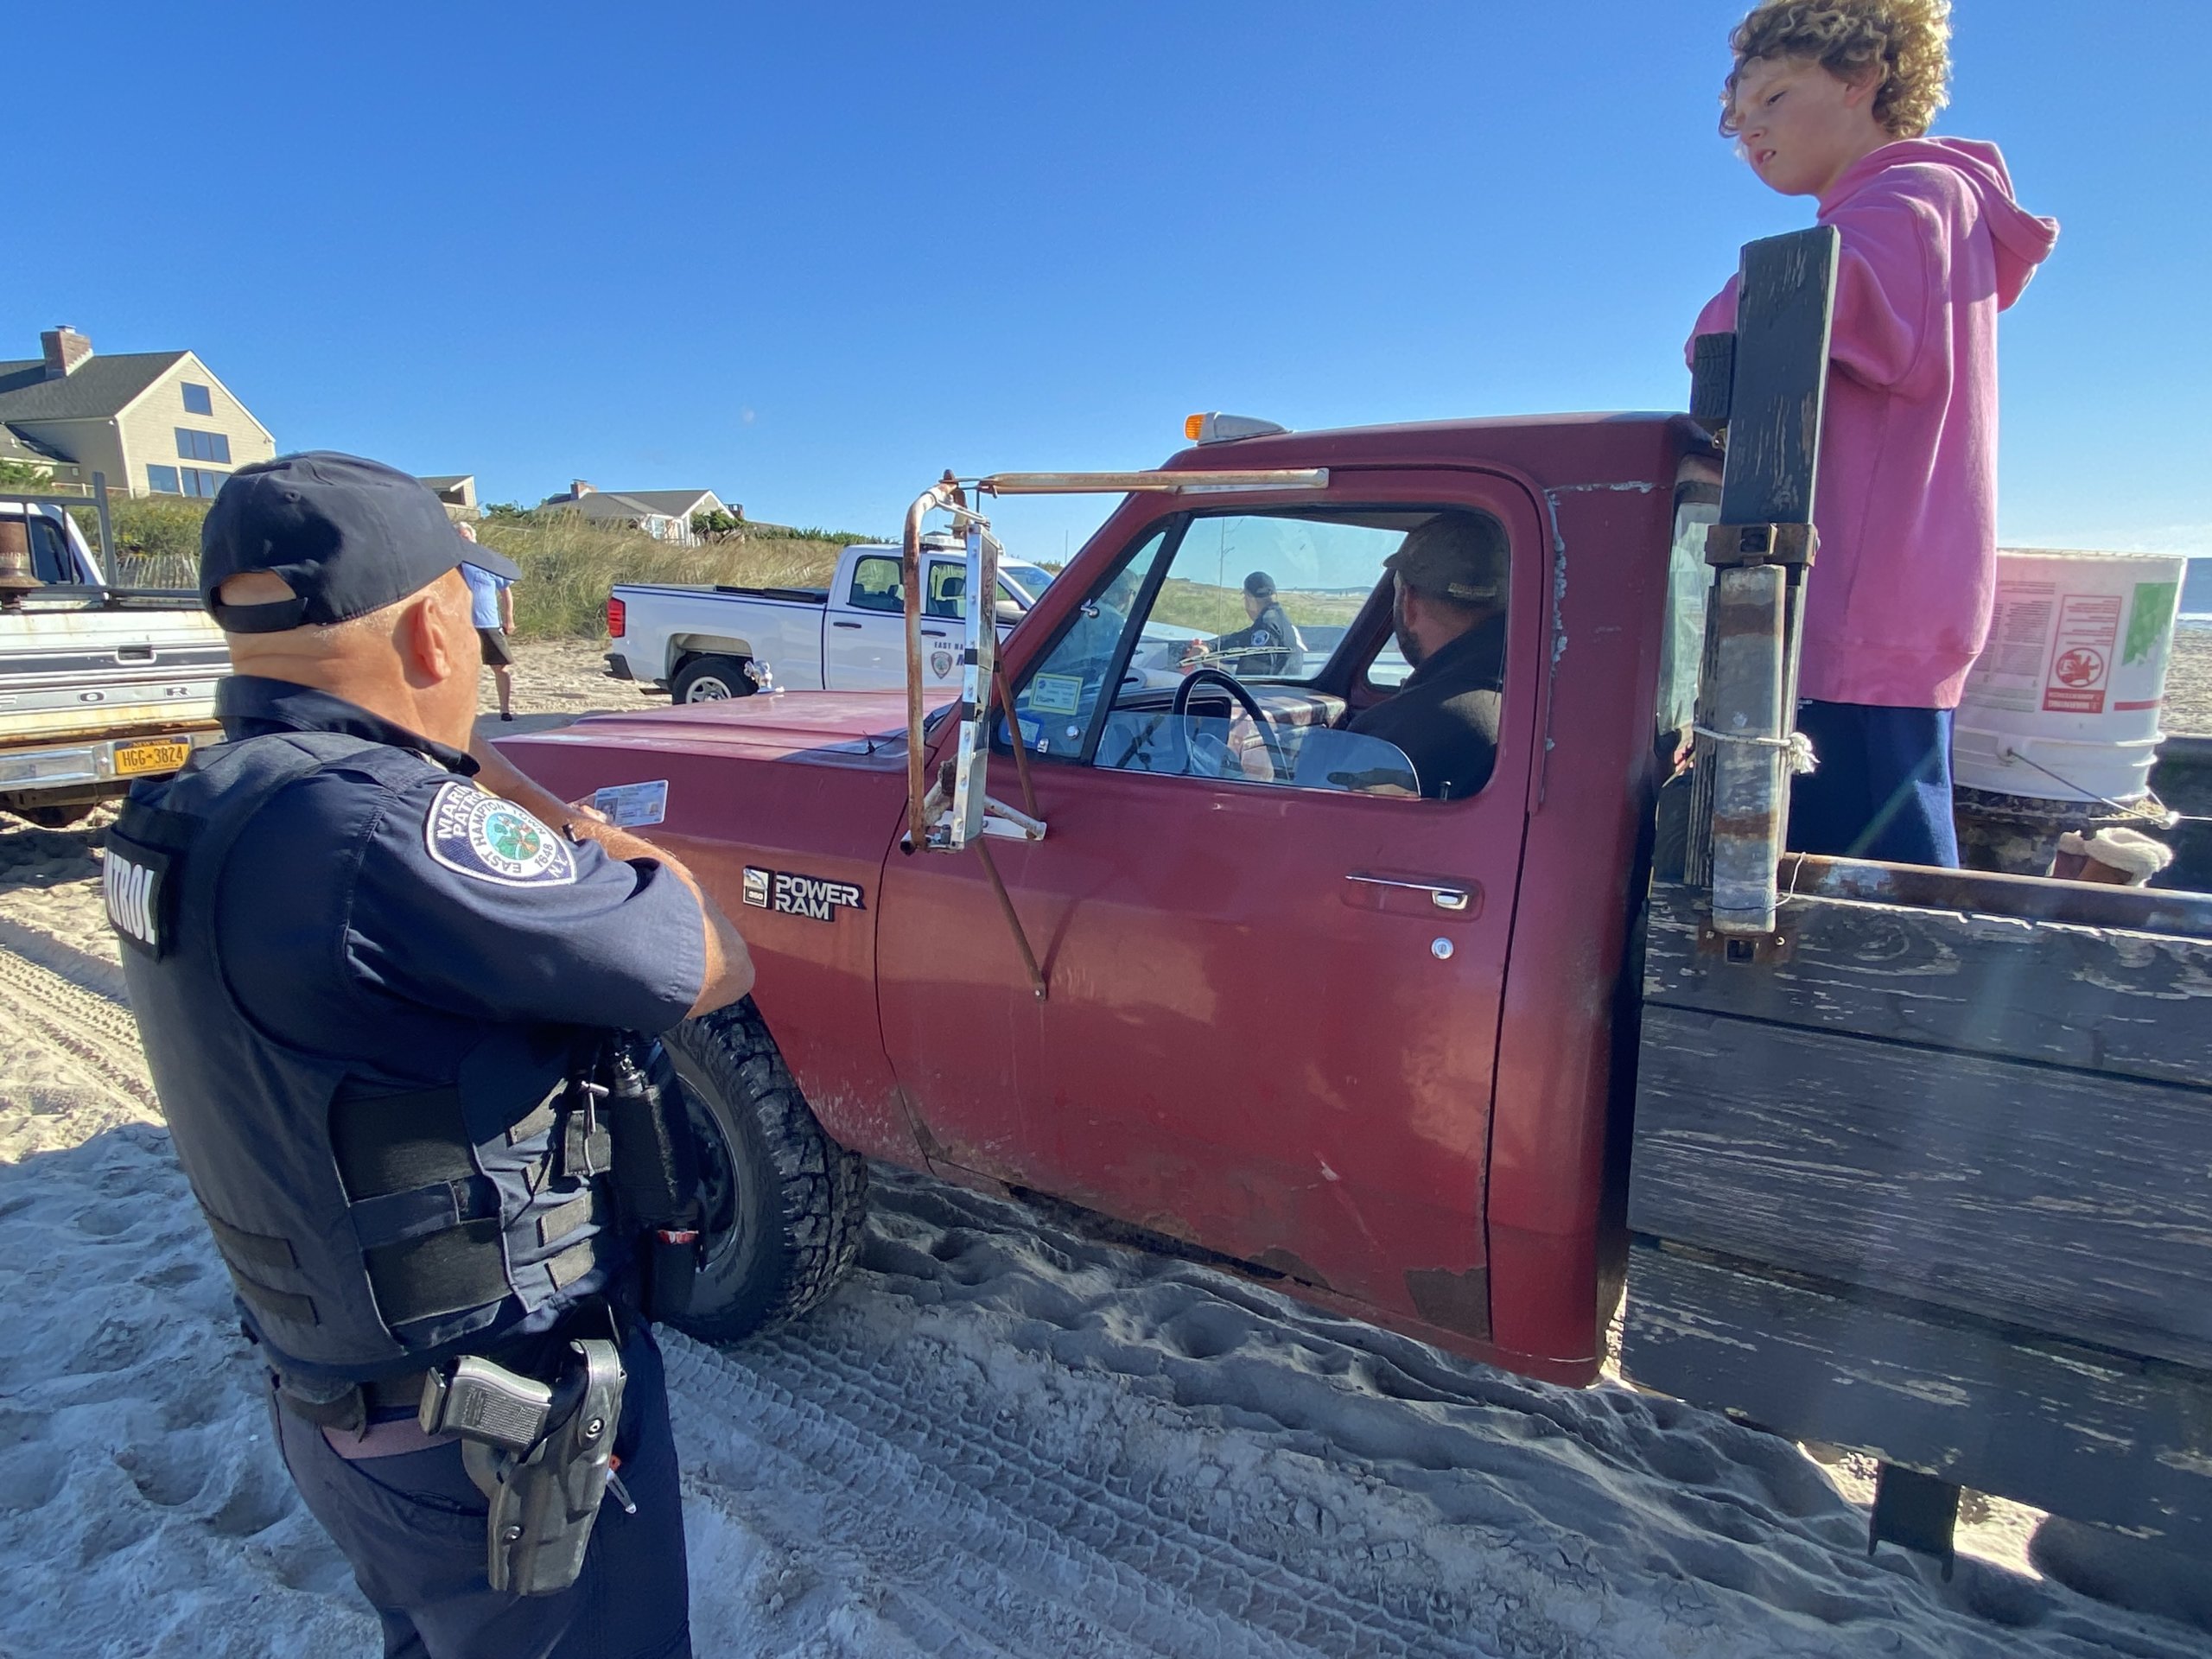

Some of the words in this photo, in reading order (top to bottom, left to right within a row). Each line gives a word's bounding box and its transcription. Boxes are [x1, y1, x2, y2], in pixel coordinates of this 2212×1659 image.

[934, 641, 951, 650] EAST
[471, 801, 506, 847] HAMPTON
[481, 849, 522, 874] EAST
[534, 842, 554, 868] 1648
[775, 874, 860, 907] POWER
[774, 893, 830, 920] RAM
